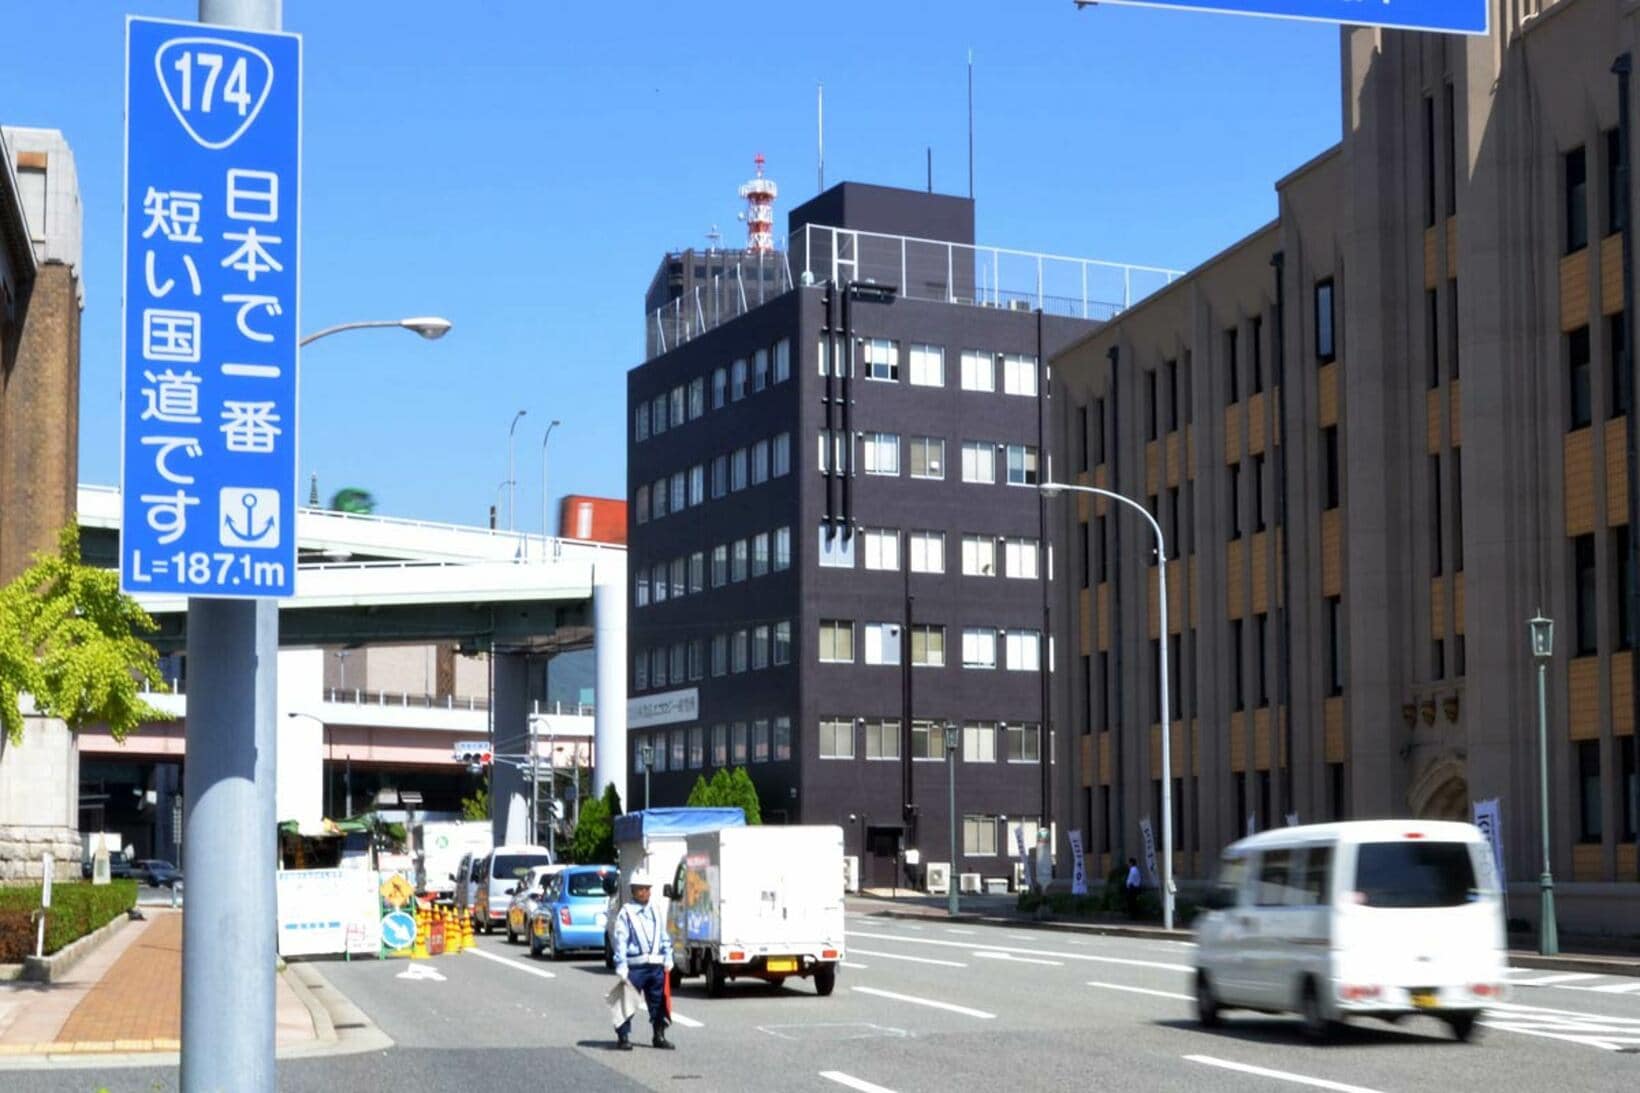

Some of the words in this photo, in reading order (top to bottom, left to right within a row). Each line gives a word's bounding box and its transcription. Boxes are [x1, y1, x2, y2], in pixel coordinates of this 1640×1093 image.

[174, 51, 251, 117] 174
[141, 186, 203, 545] 短い国道です
[220, 168, 283, 453] 日本で一番
[133, 549, 285, 587] L=187.1m
